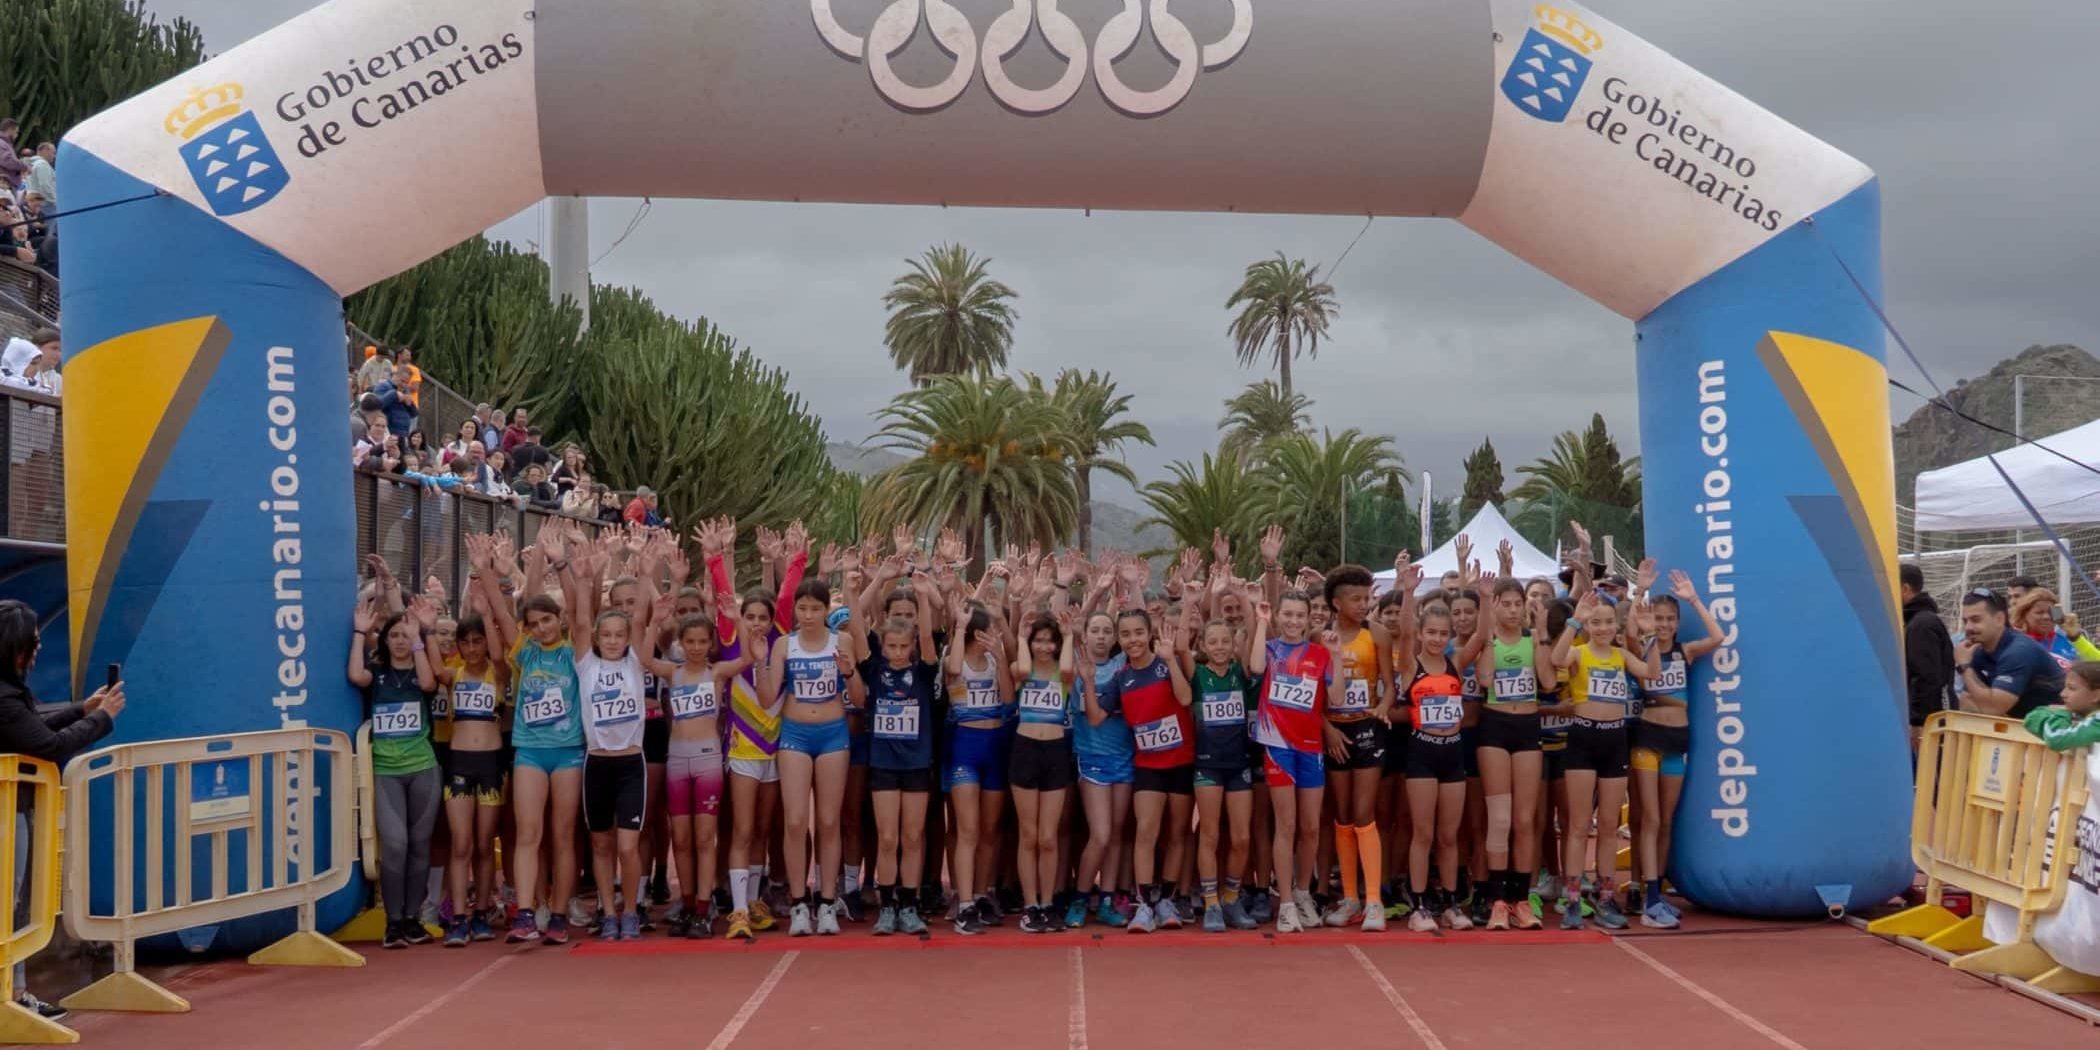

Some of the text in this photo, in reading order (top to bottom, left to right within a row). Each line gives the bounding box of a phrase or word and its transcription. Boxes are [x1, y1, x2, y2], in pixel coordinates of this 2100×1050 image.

[276, 24, 458, 122] Gobierno
[297, 32, 523, 159] de Canarias
[1602, 77, 1756, 179] Gobierno
[1586, 106, 1783, 232] de Canarias
[259, 345, 321, 864] rtecanario.com
[1696, 359, 1758, 838] deportecanario.com
[795, 679, 836, 696] 1790
[1273, 683, 1314, 706] 1722
[1496, 677, 1535, 695] 1753
[1591, 678, 1626, 697] 1759
[454, 692, 494, 709] 1750
[593, 697, 637, 719] 1729
[672, 692, 714, 713] 1798
[1023, 690, 1061, 707] 1740
[1346, 690, 1367, 706] 84
[524, 698, 564, 720] 1733
[1204, 701, 1244, 719] 1809
[1422, 705, 1462, 722] 1754
[375, 712, 419, 730] 1792
[877, 715, 915, 732] 1811
[1137, 726, 1181, 748] 1762
